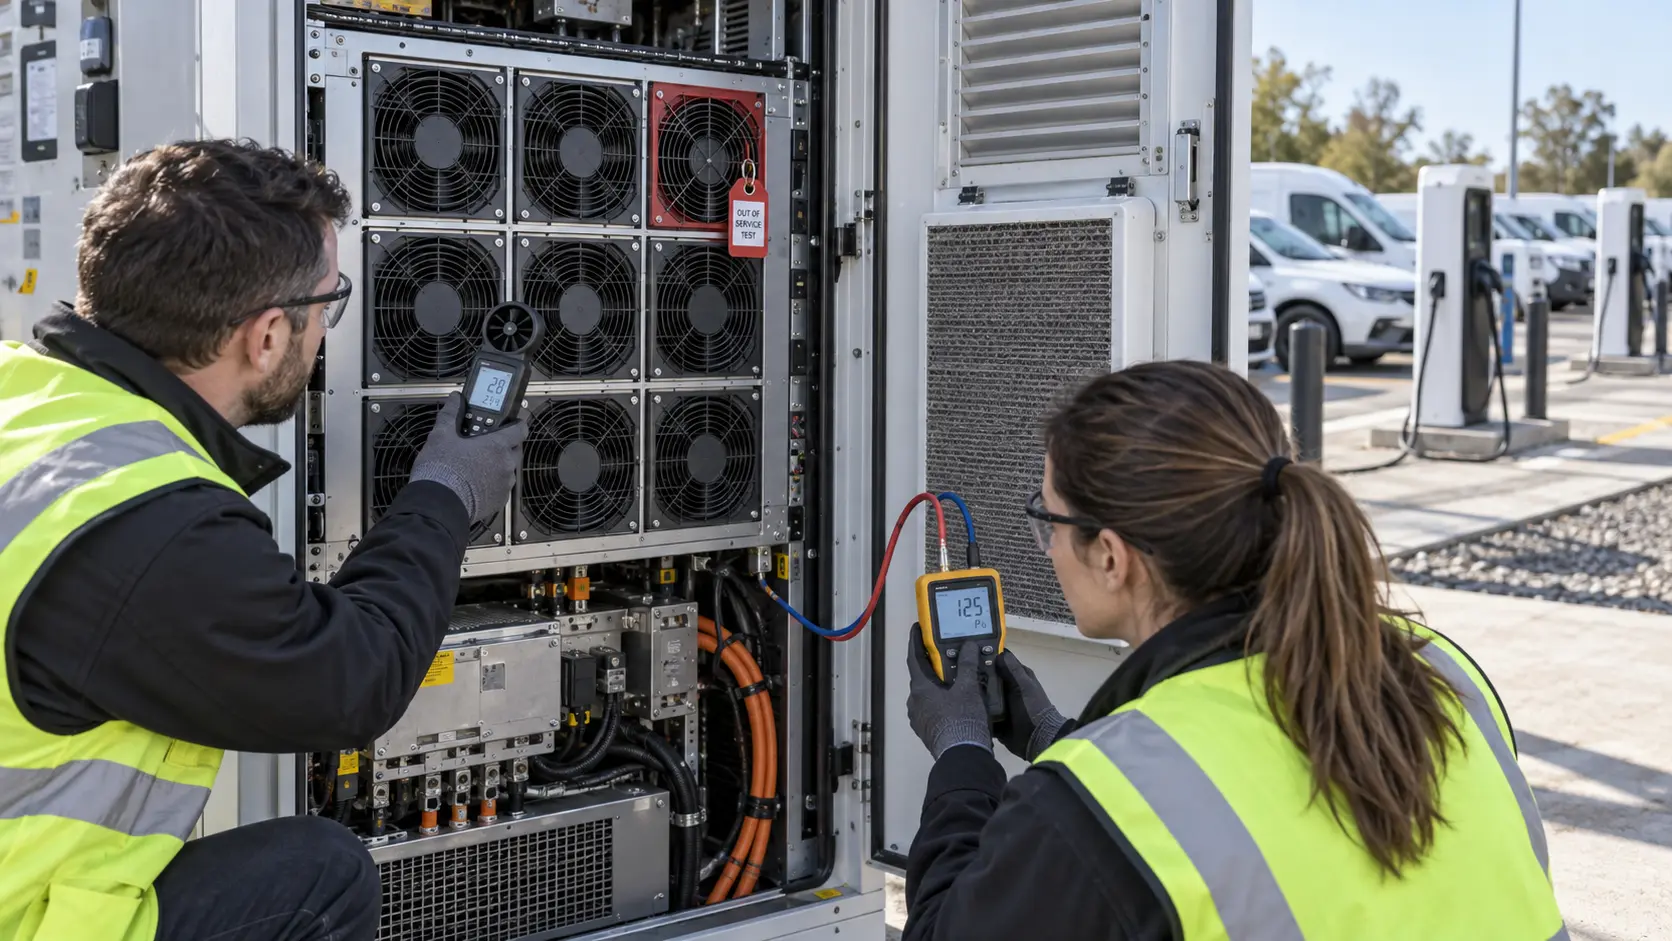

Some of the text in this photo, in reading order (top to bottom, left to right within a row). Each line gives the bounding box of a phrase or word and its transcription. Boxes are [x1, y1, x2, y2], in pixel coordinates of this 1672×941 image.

[736, 220, 762, 228] SERVICE
[741, 231, 756, 239] TEST
[487, 377, 506, 394] 28
[958, 596, 982, 618] 125
